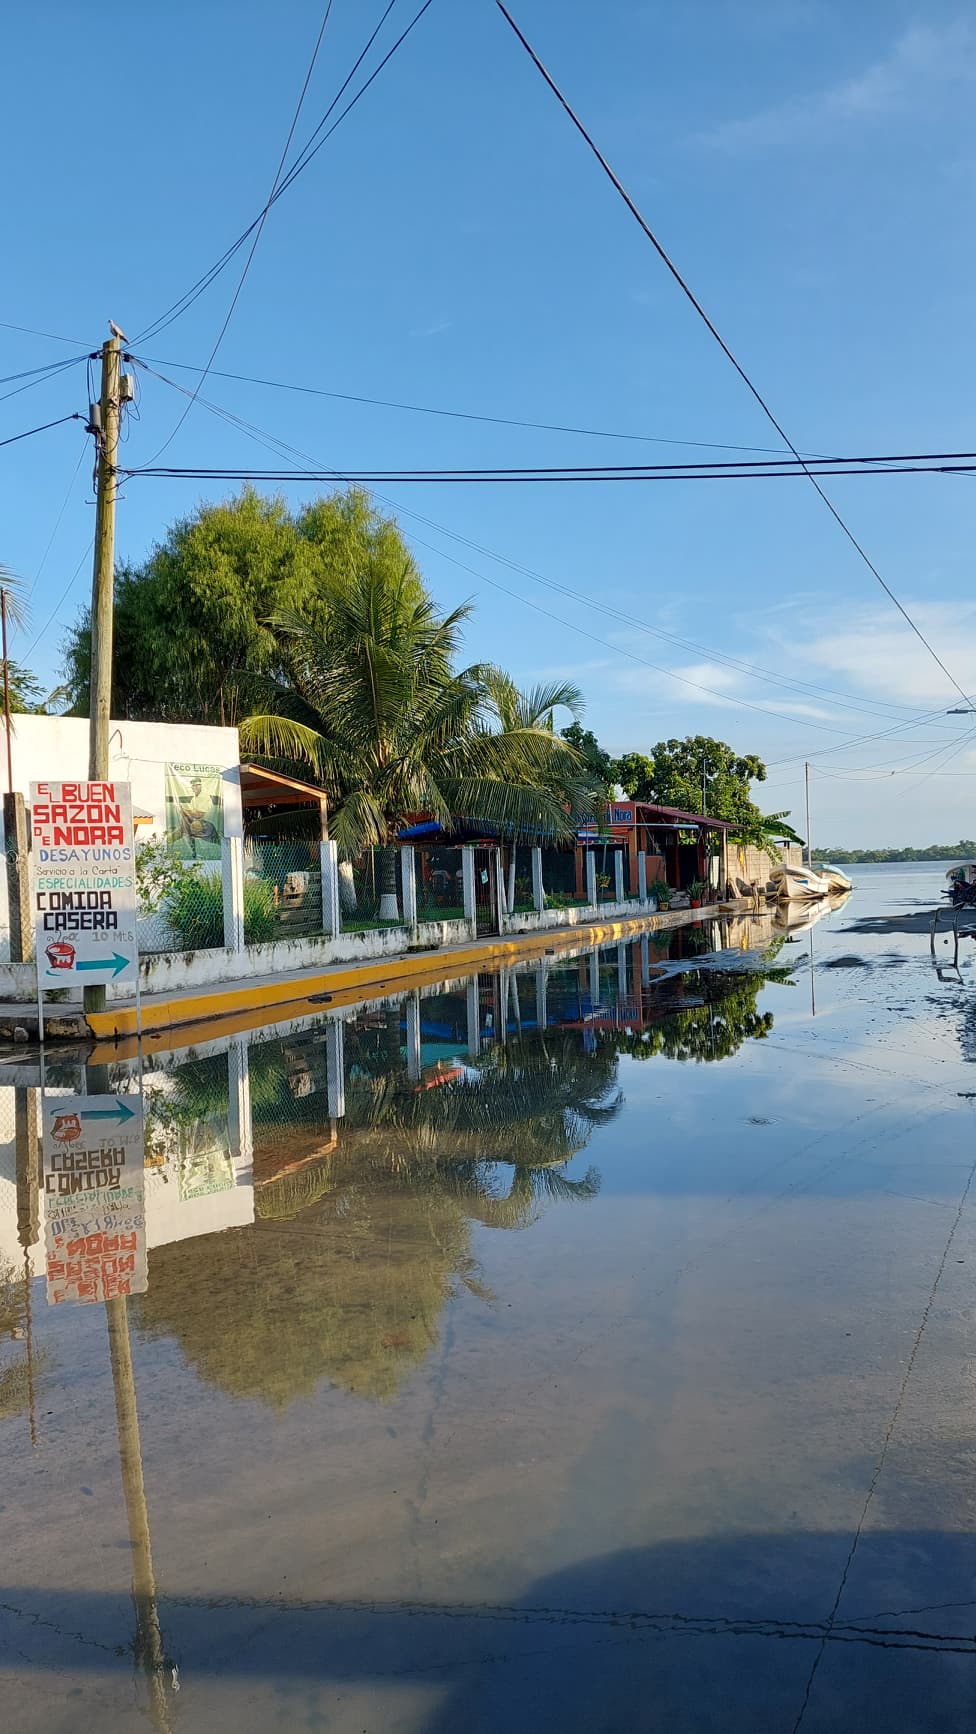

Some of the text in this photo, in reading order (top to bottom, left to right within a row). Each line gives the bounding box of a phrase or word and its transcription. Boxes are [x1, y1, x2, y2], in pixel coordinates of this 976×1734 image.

[193, 763, 221, 774] Lucas
[37, 784, 115, 803] EL BUEN
[33, 805, 120, 824] SAZON
[614, 808, 632, 822] Nora
[34, 826, 124, 846] DE NORA
[39, 848, 131, 862] DESAYUNOS
[38, 876, 133, 889] ESPECIALIDADES
[36, 891, 112, 911] COMIDA
[43, 911, 118, 931] CASERA
[92, 931, 108, 941] 10
